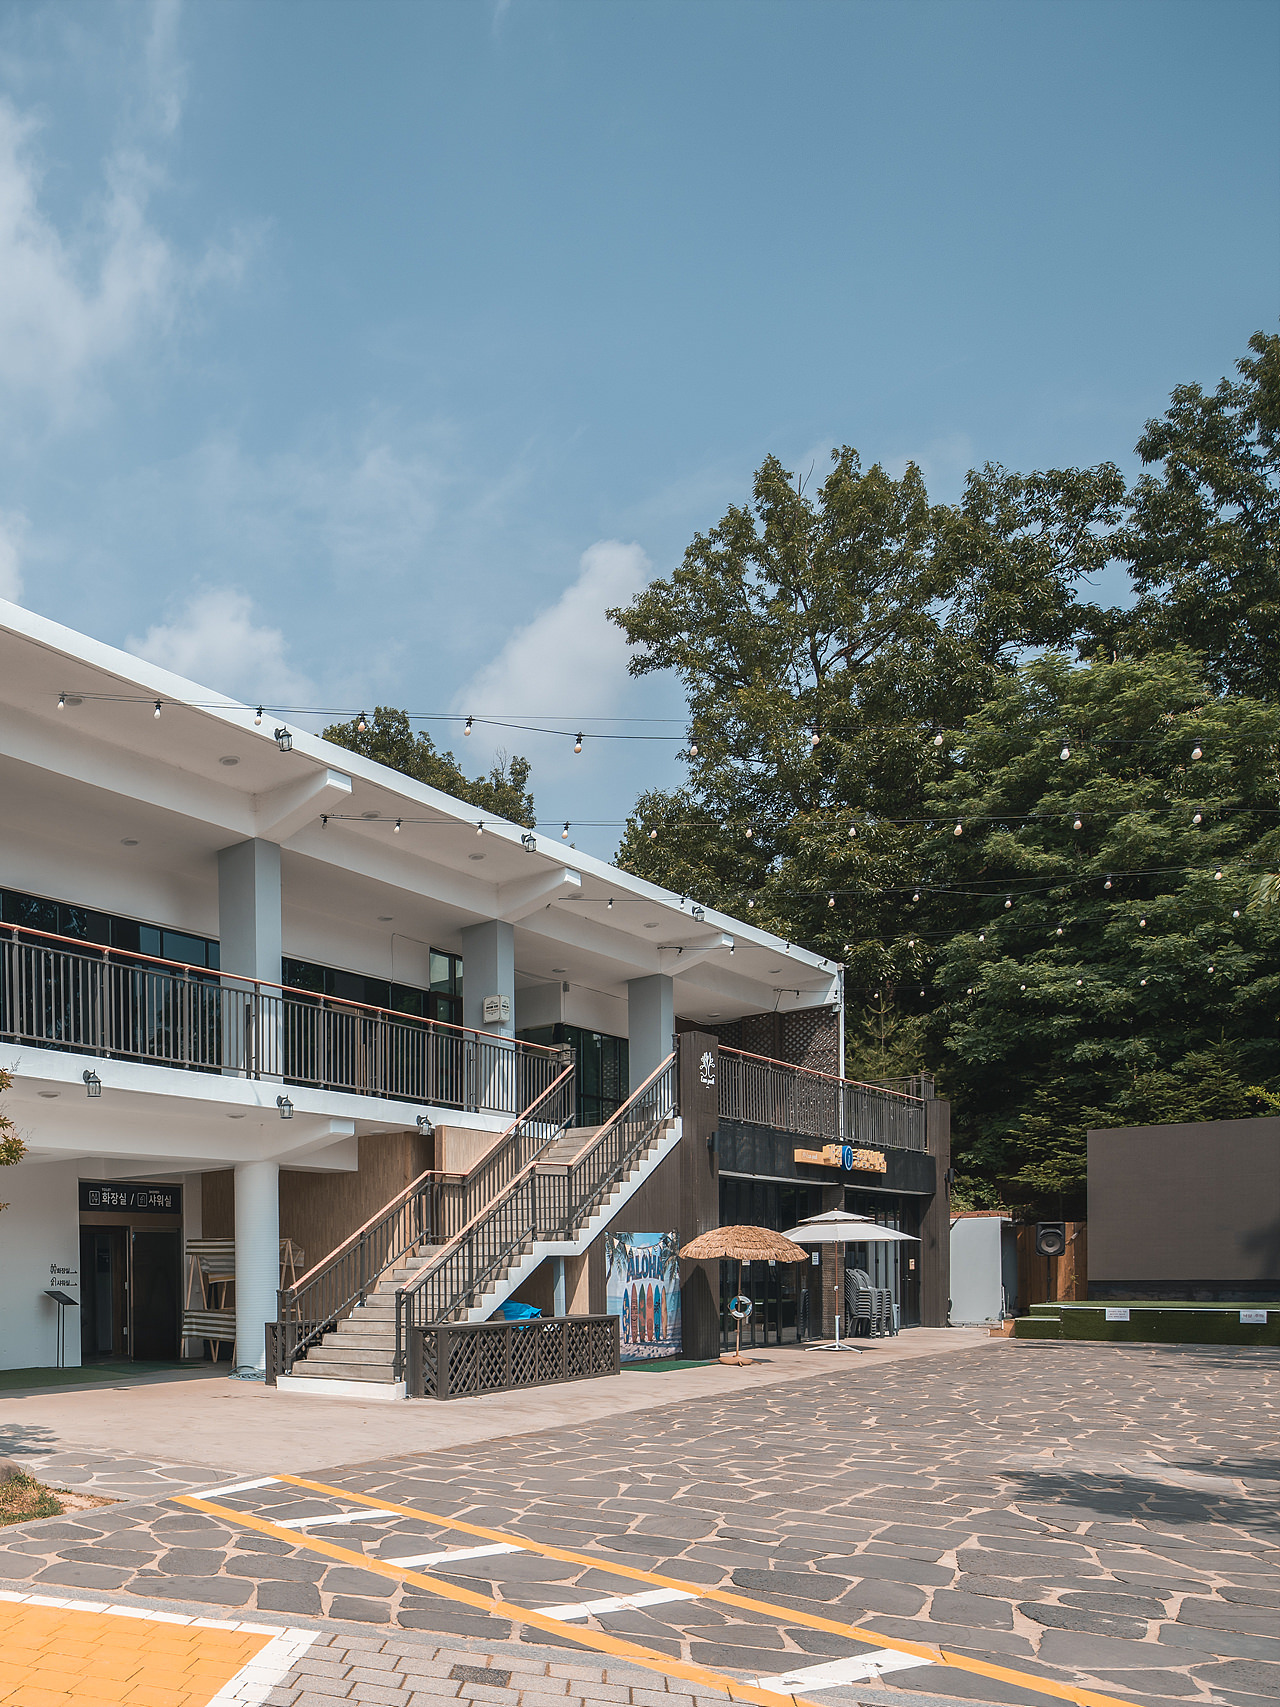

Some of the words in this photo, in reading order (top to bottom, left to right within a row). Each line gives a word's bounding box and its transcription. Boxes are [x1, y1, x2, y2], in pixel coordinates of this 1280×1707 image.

[101, 1191, 127, 1206] 화장실
[148, 1194, 172, 1208] 샤워실
[626, 1254, 665, 1283] ALOHA
